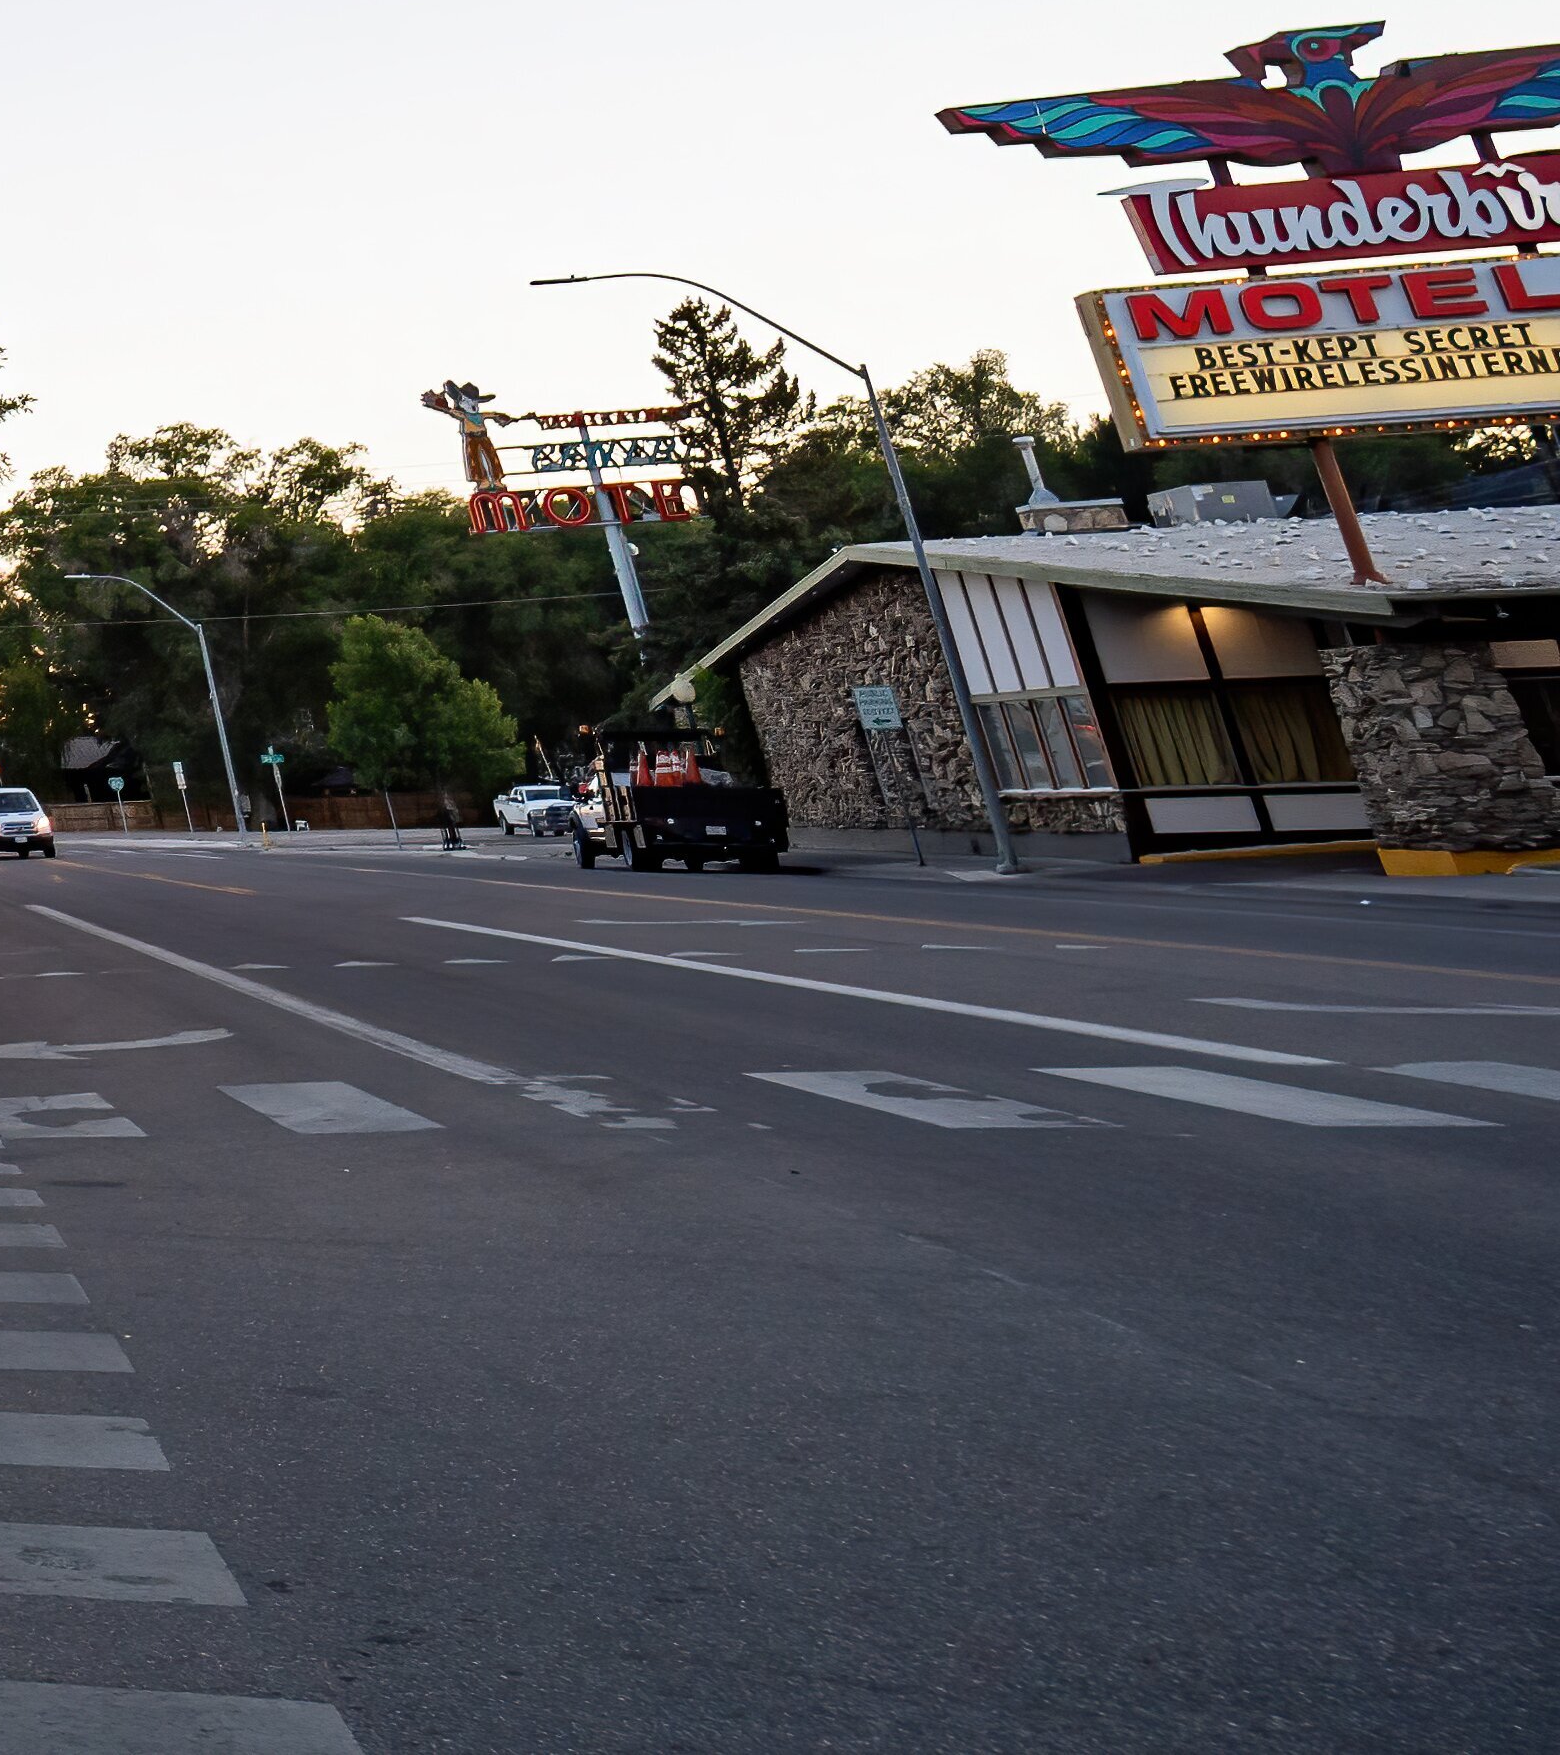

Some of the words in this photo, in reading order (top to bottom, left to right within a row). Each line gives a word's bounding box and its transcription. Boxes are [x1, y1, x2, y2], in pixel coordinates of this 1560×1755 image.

[1124, 263, 1560, 341] MOTEL
[1195, 334, 1378, 371] BEST-KEPT
[1403, 322, 1533, 356] SECRET
[468, 479, 691, 534] MOTE
